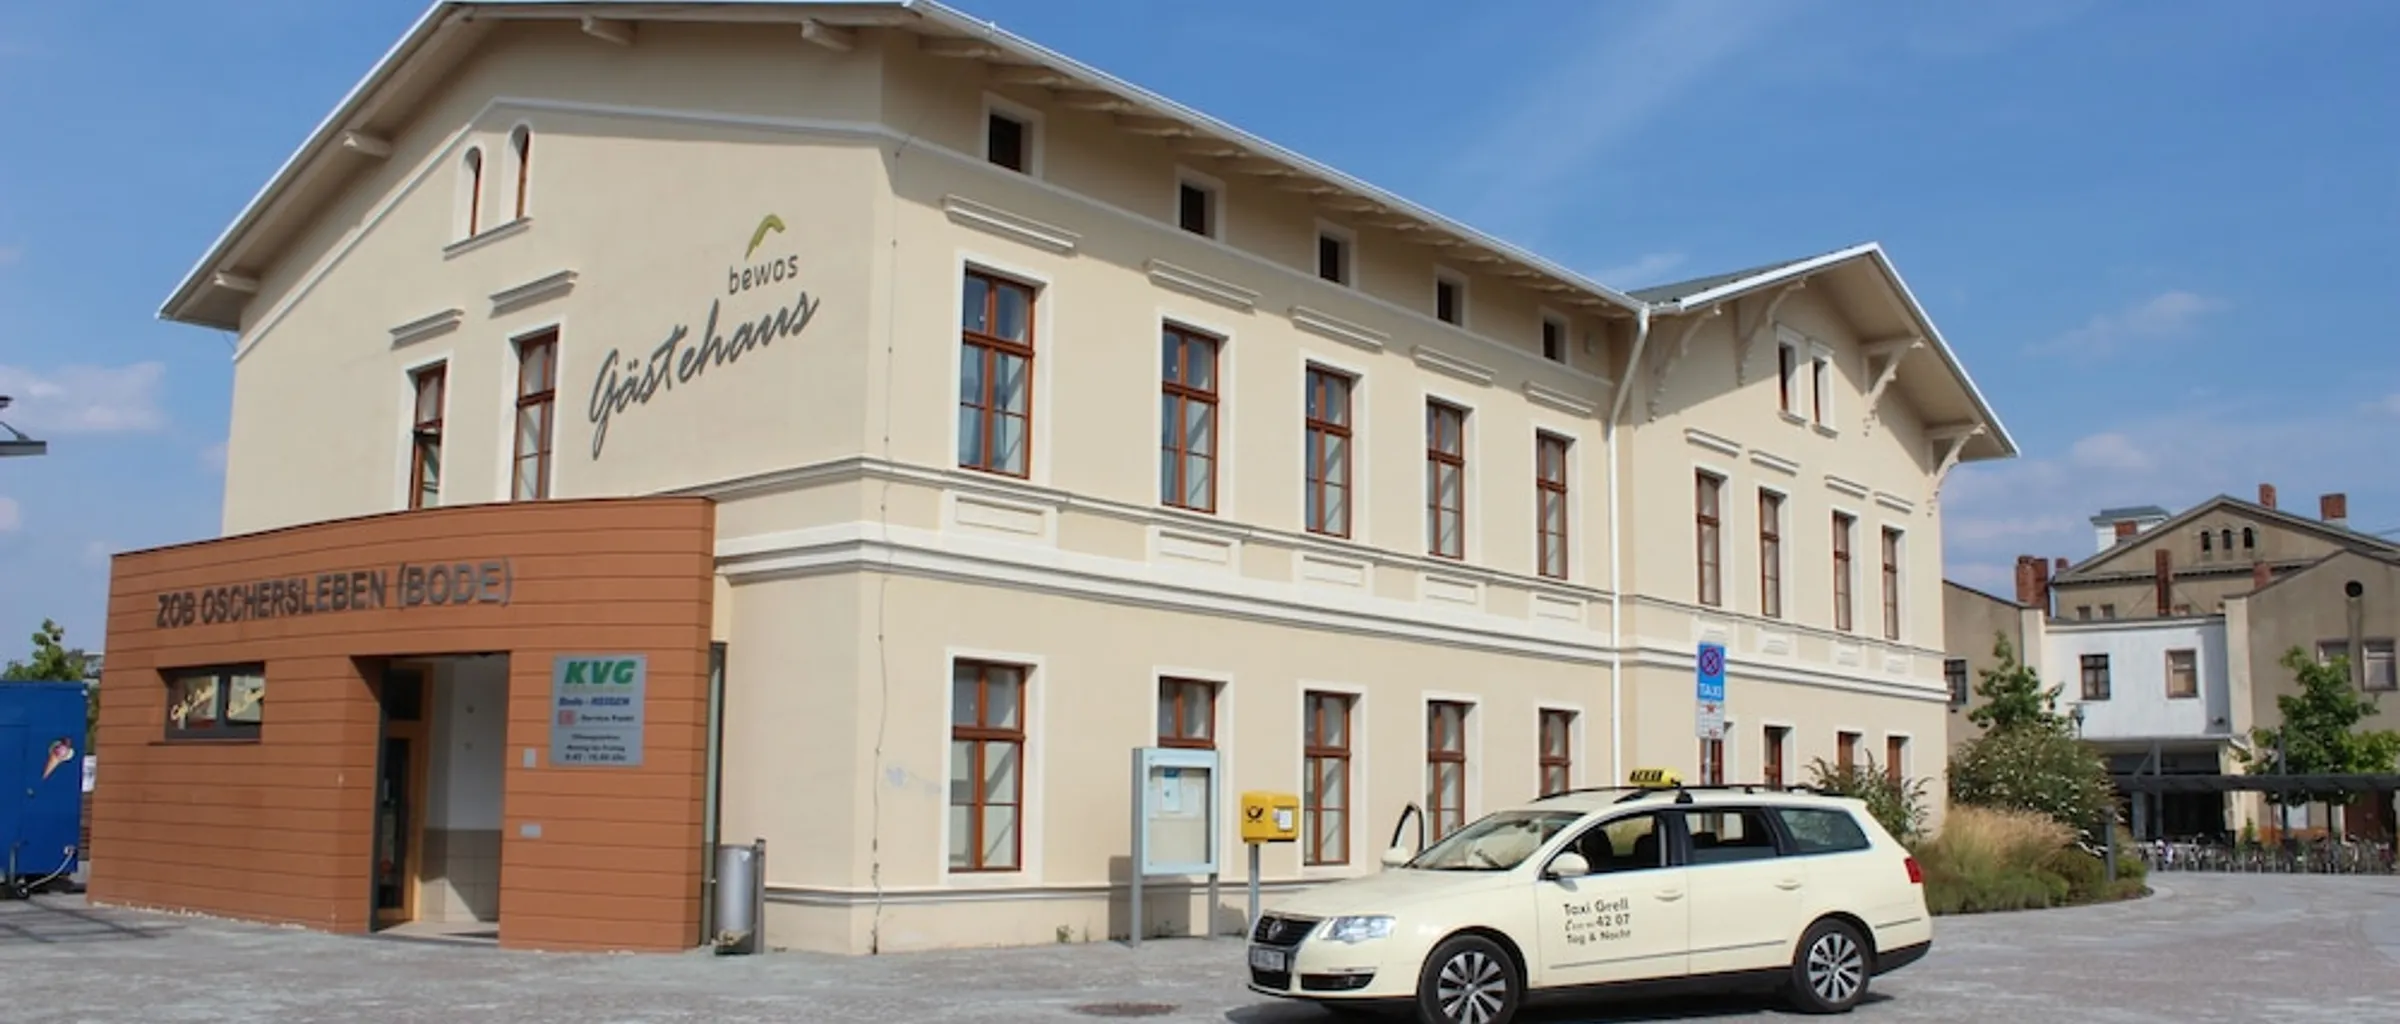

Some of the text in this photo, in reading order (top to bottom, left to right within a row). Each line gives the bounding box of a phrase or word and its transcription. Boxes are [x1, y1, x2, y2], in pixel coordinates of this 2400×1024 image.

[728, 254, 799, 295] bewos
[589, 291, 820, 461] Gästehaus
[156, 557, 514, 628] ZOB OSCHERSLEBEN (BODE)
[564, 660, 636, 685] KVG
[1699, 683, 1722, 697] TAXI
[1563, 902, 1591, 916] Taxi
